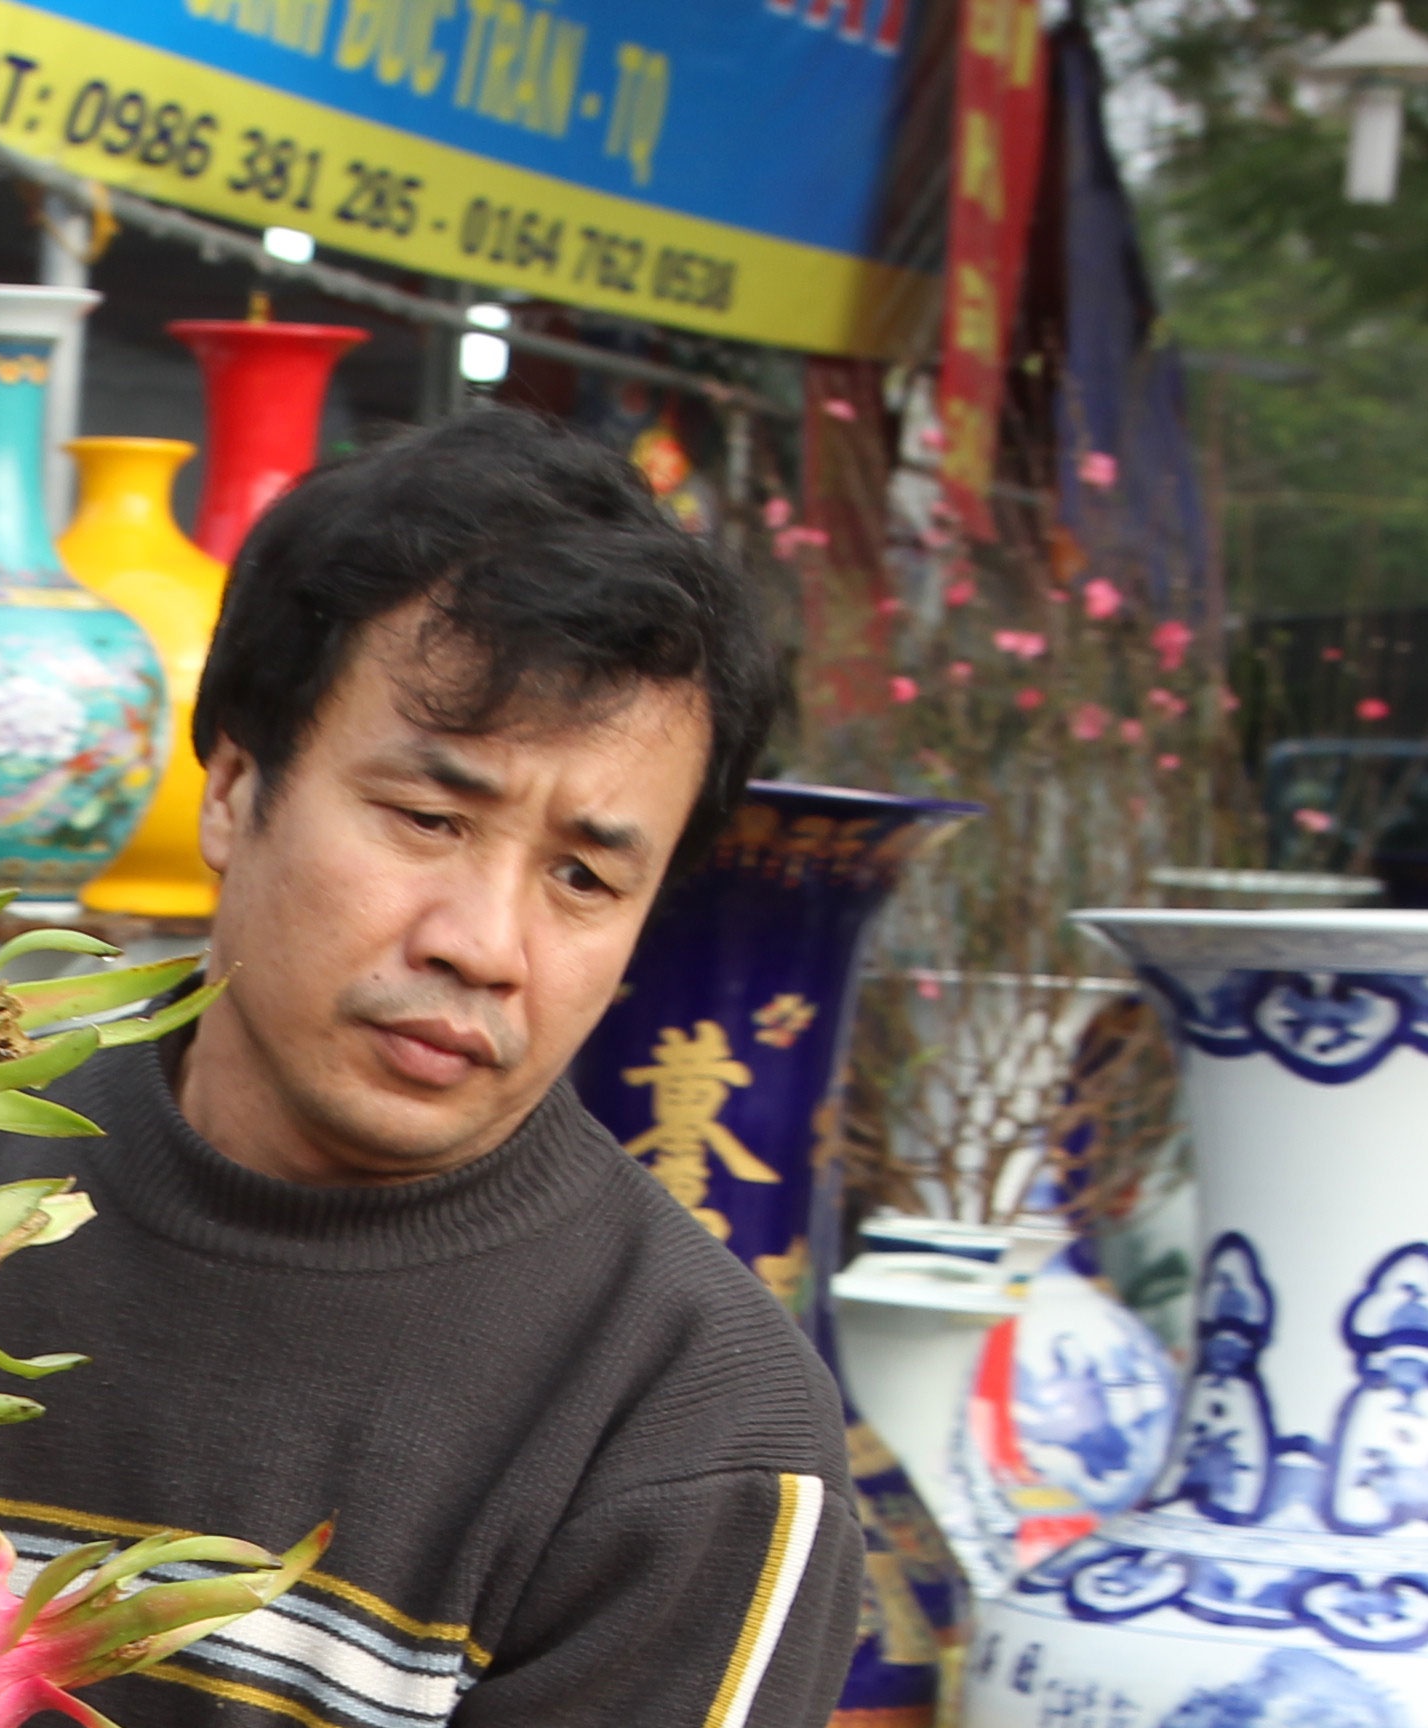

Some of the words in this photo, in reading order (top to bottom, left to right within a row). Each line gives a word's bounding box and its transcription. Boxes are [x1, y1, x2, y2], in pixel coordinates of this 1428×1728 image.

[63, 79, 218, 178] 0986
[228, 128, 322, 211] 381
[459, 198, 565, 275] 0164
